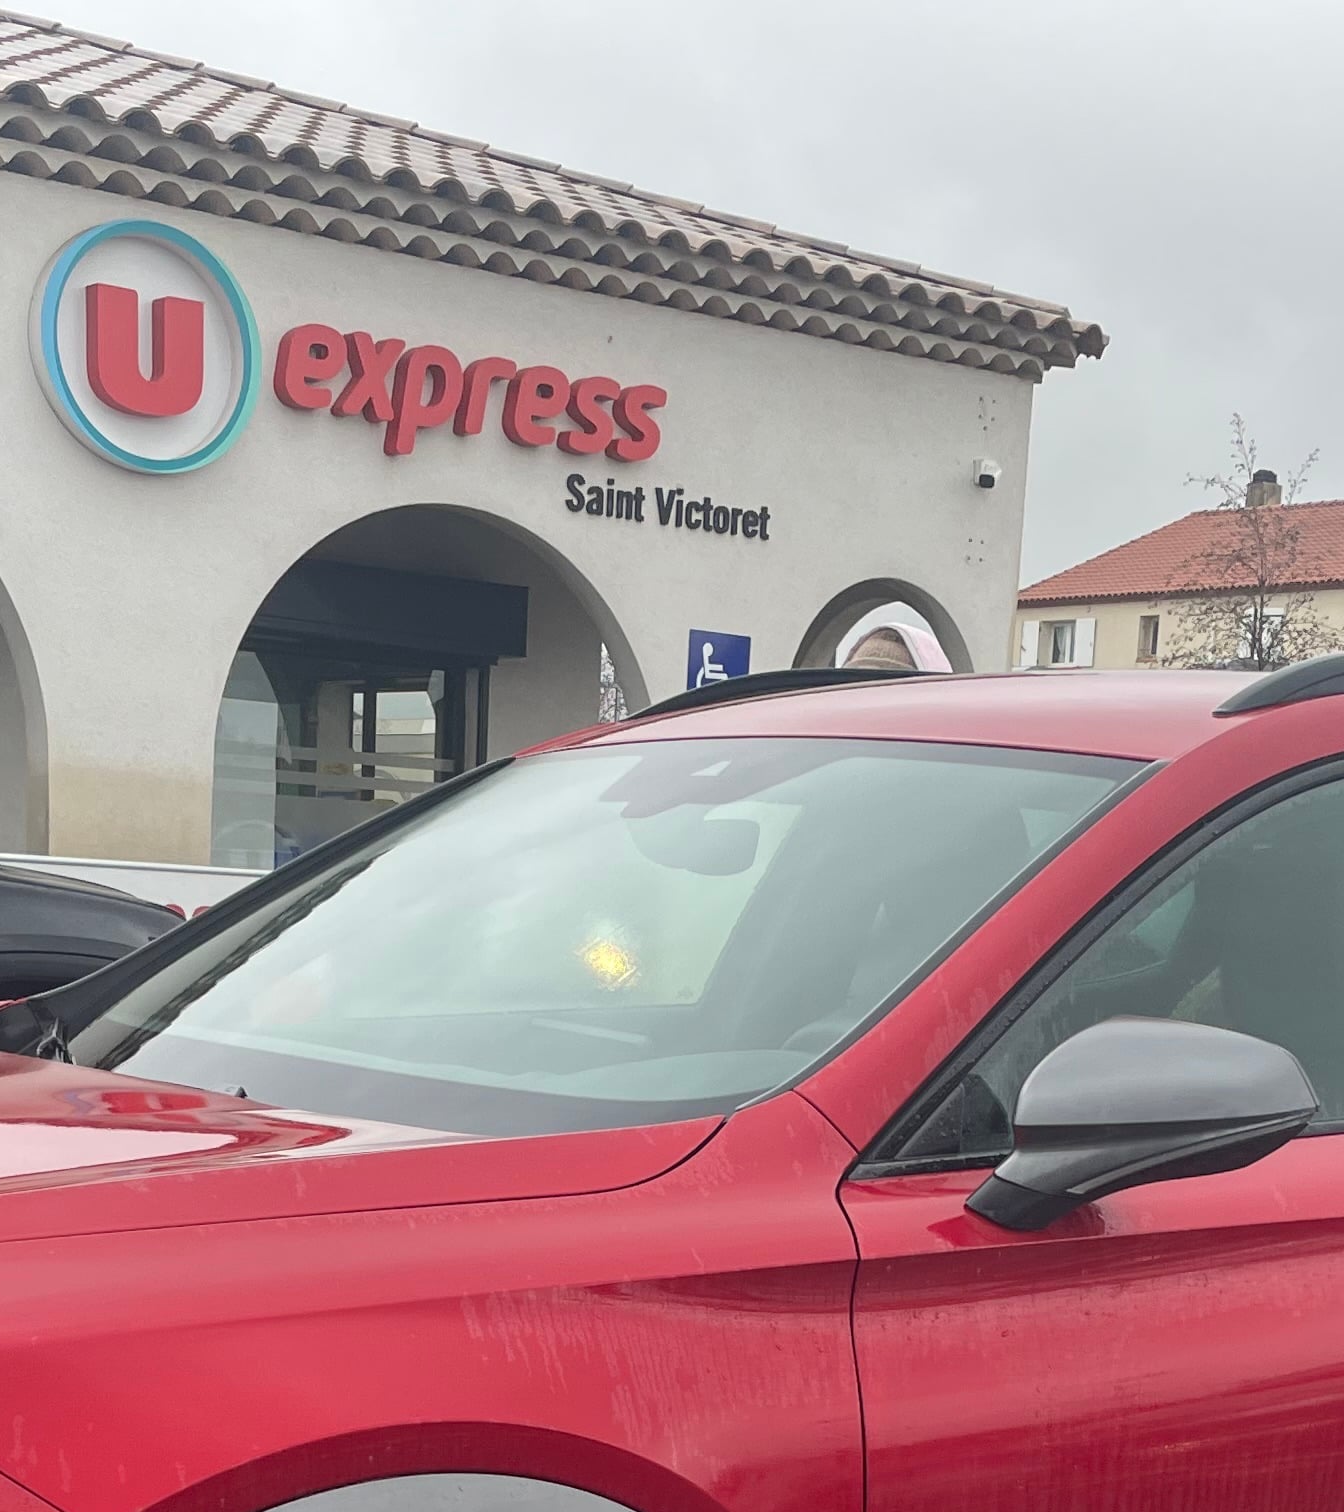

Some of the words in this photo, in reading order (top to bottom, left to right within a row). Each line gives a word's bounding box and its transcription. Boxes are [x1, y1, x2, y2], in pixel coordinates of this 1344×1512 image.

[85, 282, 205, 418] U
[273, 323, 667, 463] express
[565, 473, 645, 522] Saint
[654, 486, 770, 540] Victoret
